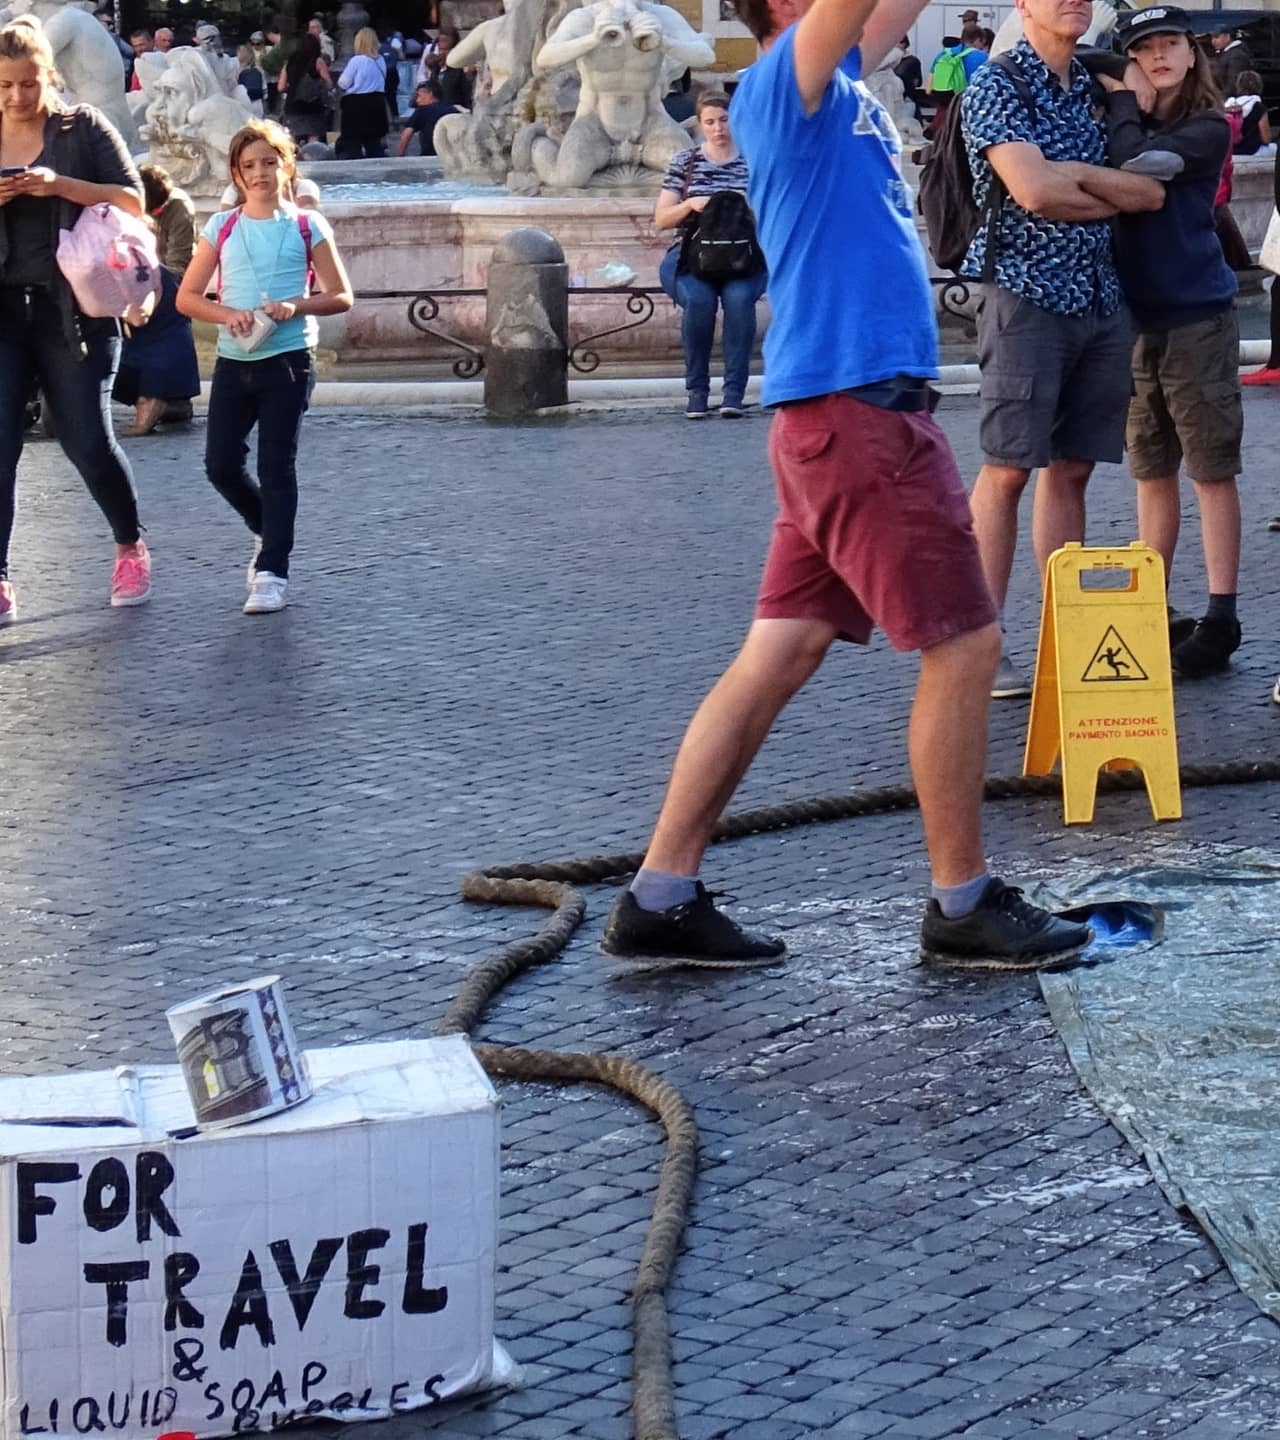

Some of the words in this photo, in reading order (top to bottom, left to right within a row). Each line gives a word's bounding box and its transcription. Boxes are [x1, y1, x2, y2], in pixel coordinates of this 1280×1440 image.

[1068, 728, 1121, 740] PAVIMENTO
[1125, 727, 1169, 738] BAGNATO
[1078, 716, 1160, 727] ATTENZIONE
[16, 1151, 181, 1245] FOR
[83, 1222, 448, 1350] TRAVEL
[172, 1337, 207, 1383] &
[20, 1386, 178, 1435] LIQUID
[203, 1361, 328, 1420] SOAP
